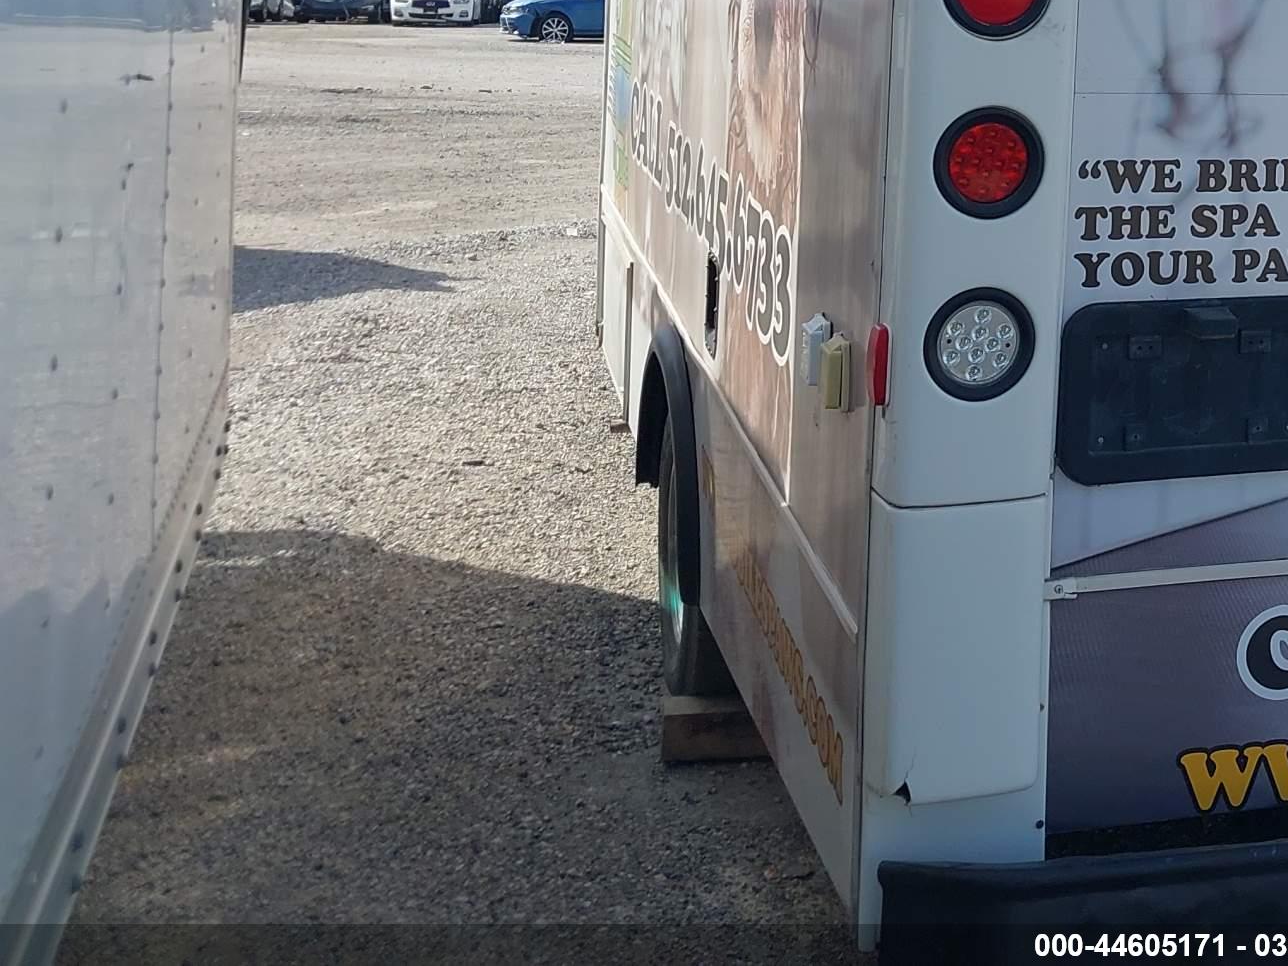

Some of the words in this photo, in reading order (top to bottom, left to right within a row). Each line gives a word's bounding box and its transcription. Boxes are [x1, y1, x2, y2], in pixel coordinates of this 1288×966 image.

[631, 79, 662, 187] CALL
[665, 121, 791, 364] 512.645.6733
[1074, 204, 1177, 241] THE
[1190, 203, 1280, 238] SPA
[1073, 250, 1217, 288] YOUR
